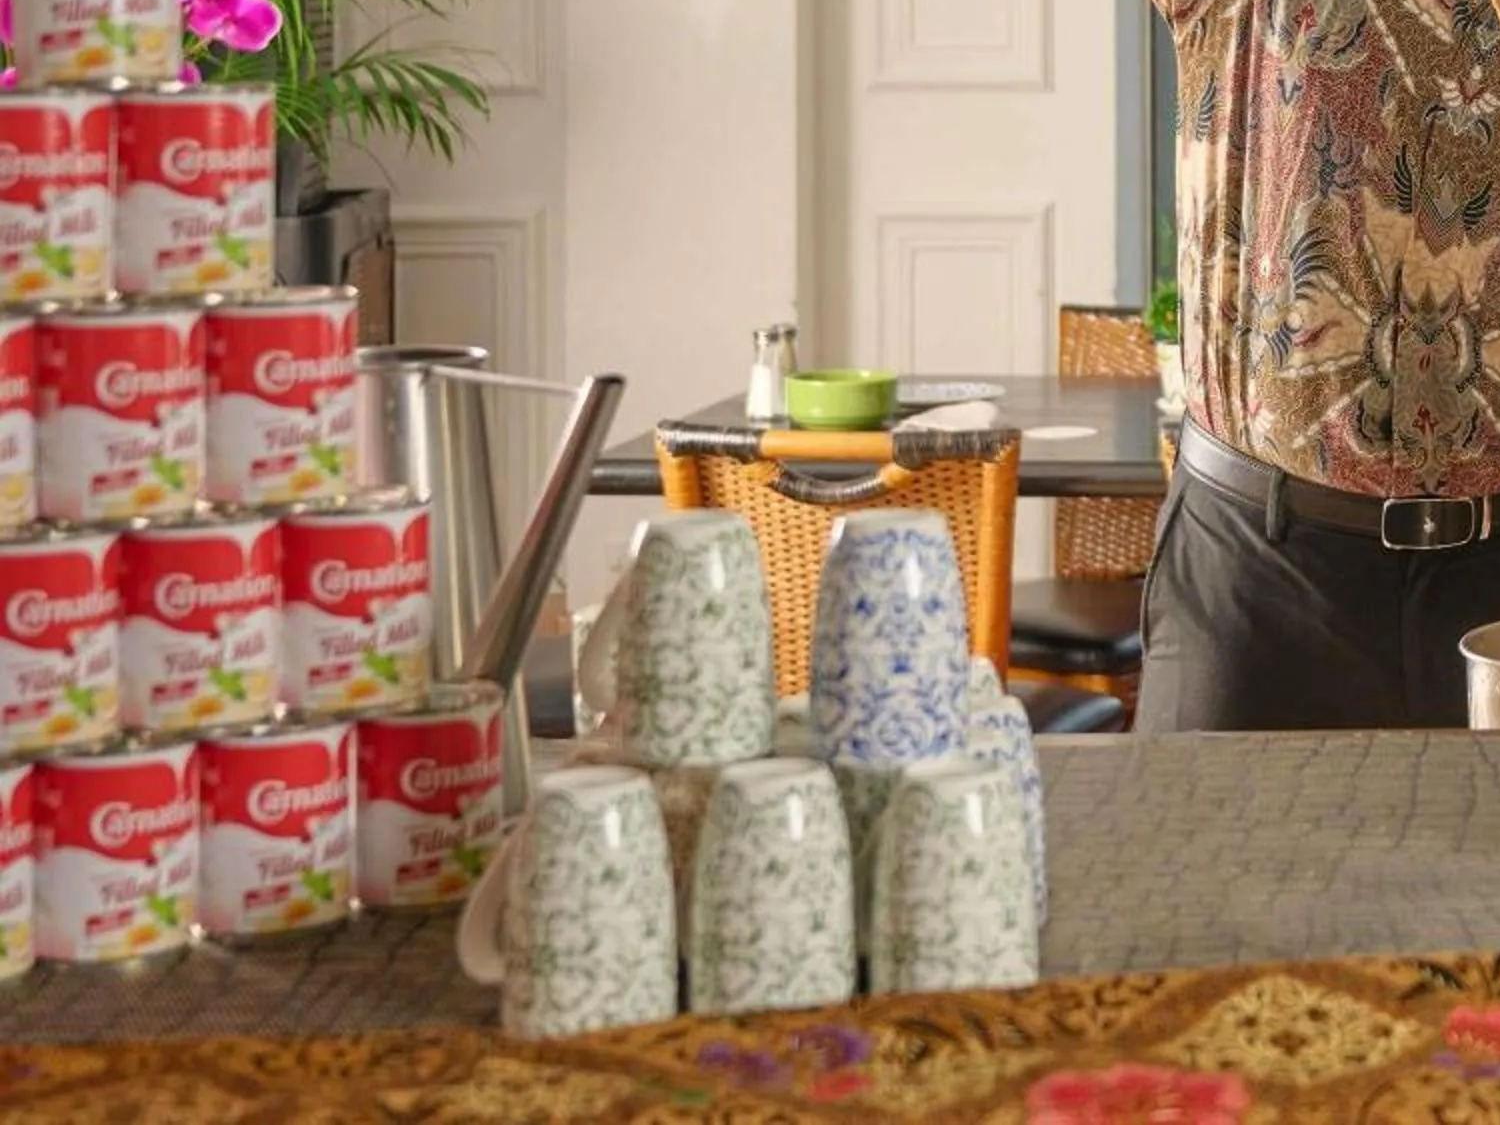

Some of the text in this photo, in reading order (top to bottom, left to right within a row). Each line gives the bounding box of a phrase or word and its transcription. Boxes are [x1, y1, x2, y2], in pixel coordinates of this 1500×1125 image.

[161, 138, 274, 184] Carnatio
[254, 349, 358, 396] Carnatio
[6, 586, 119, 637] Carnatio
[90, 796, 196, 848] Carnatio
